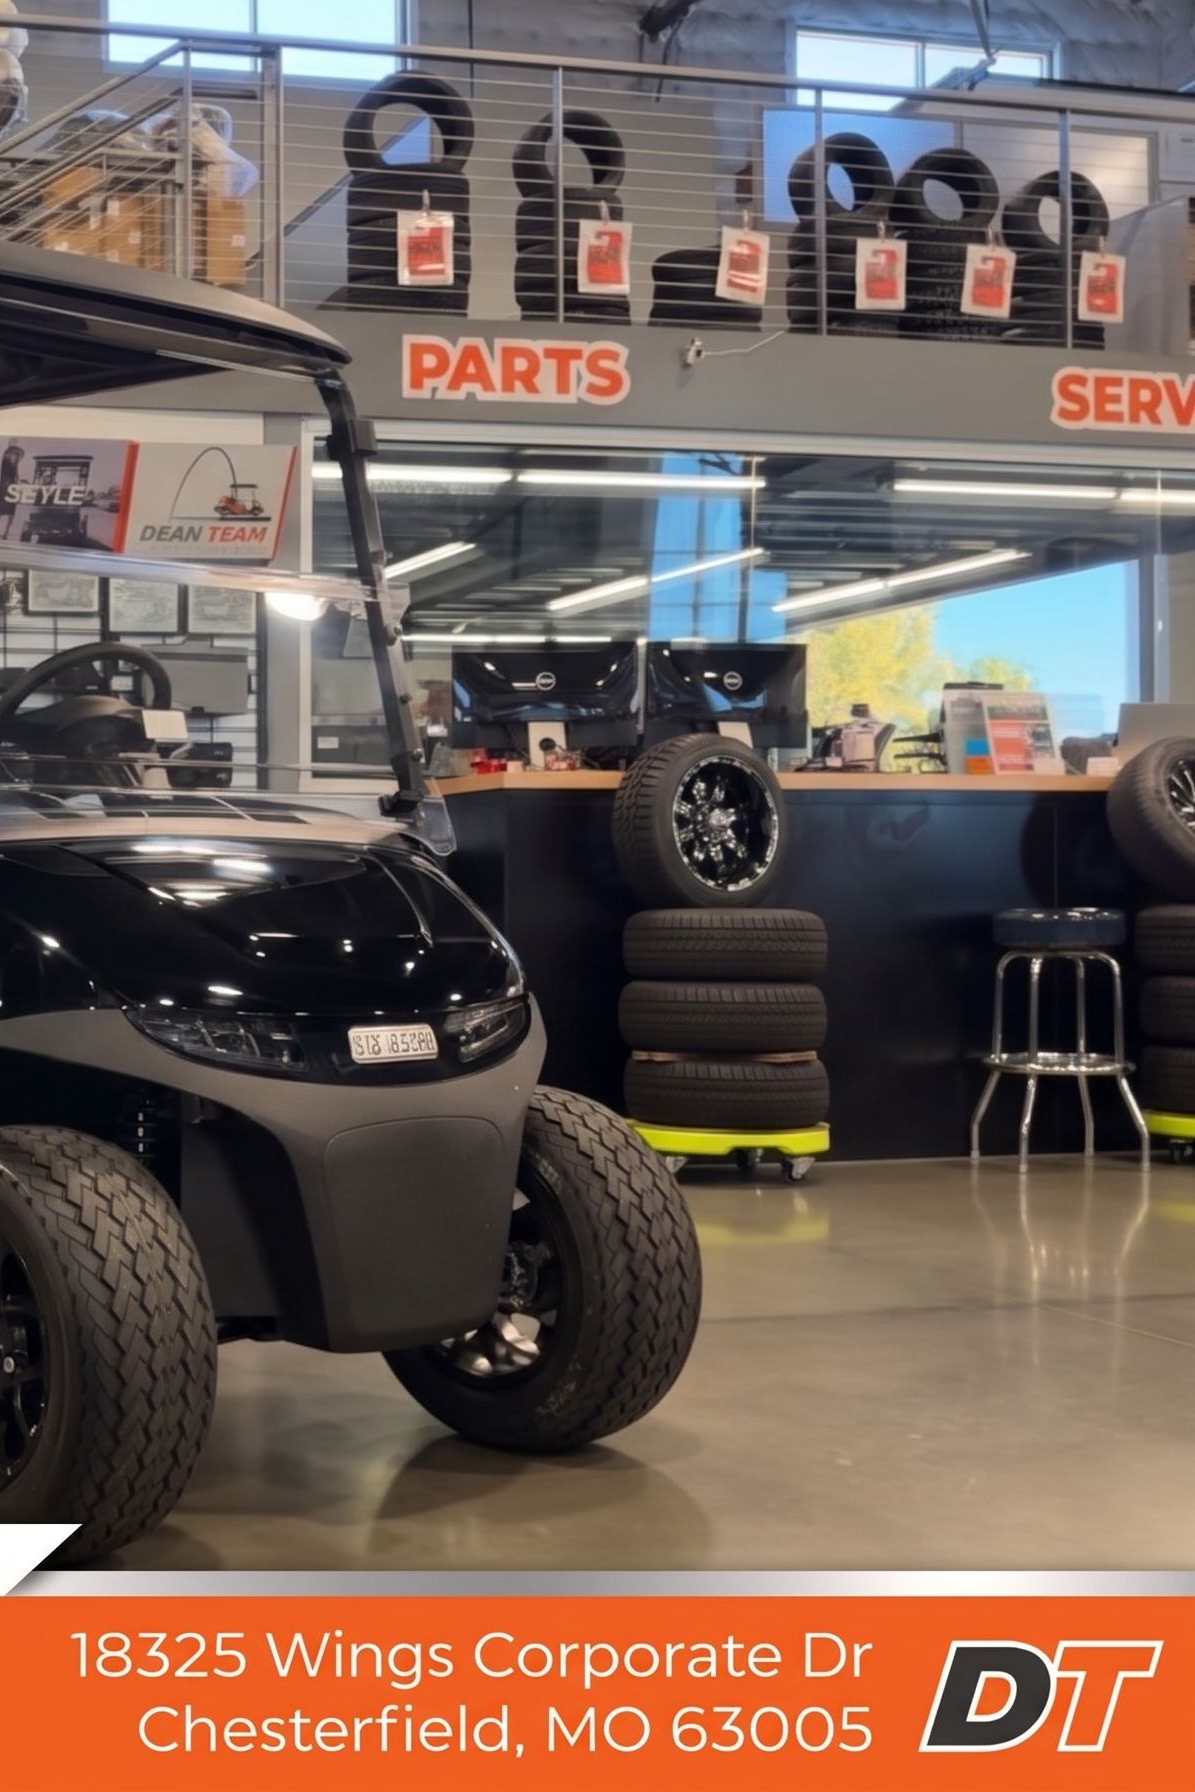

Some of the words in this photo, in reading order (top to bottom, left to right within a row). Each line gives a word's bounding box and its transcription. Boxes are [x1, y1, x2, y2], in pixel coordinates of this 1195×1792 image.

[406, 339, 627, 401] PARTS
[139, 525, 203, 543] DEAN
[208, 526, 268, 544] TEAM
